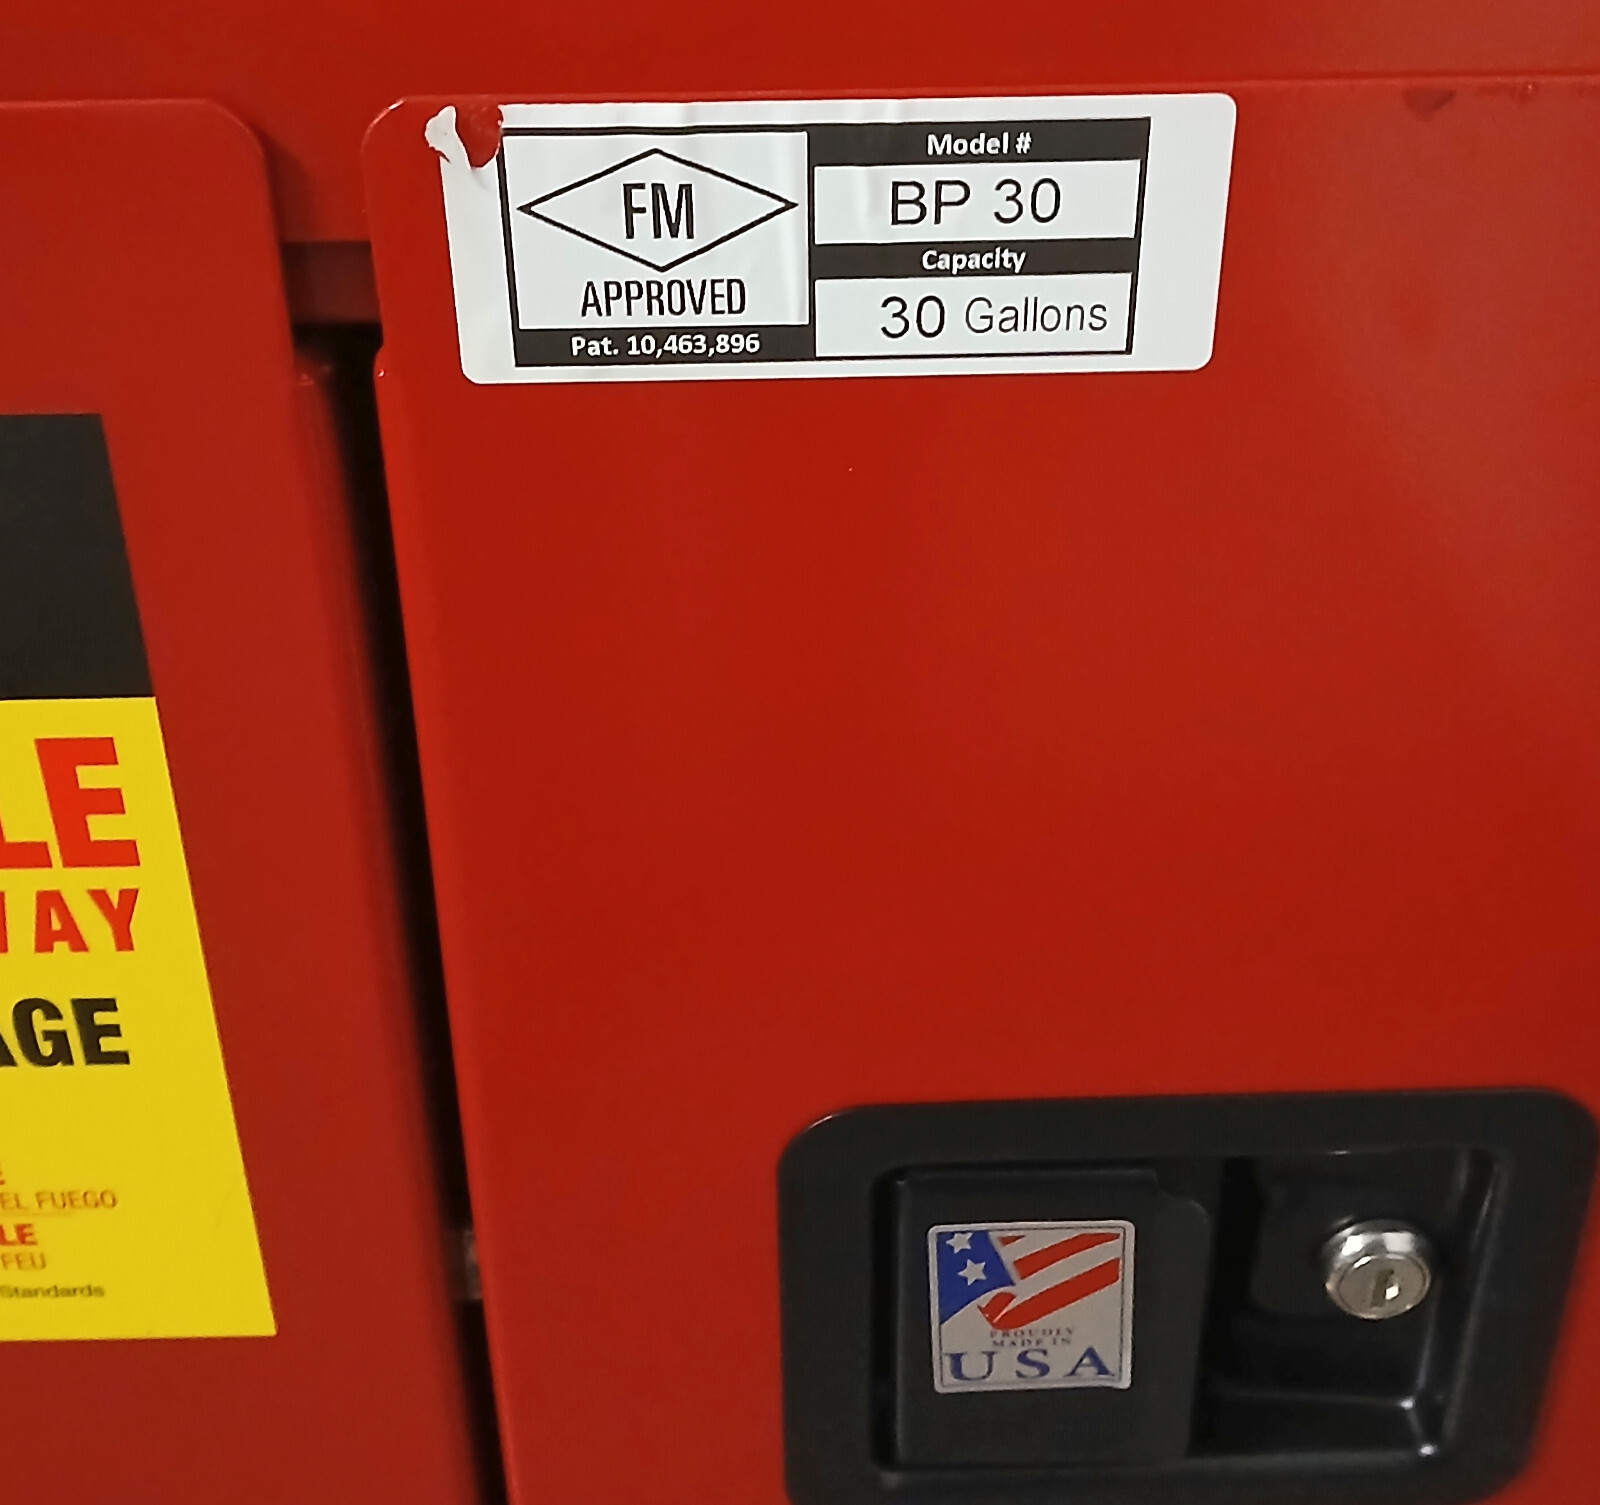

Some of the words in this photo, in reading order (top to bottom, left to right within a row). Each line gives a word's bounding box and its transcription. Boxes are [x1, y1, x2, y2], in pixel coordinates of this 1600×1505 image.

[928, 131, 1009, 157] Model
[1013, 130, 1033, 155] #
[622, 181, 697, 241] FM
[889, 180, 972, 227] BP
[992, 178, 1062, 225] 30
[922, 247, 1027, 275] Capacity
[580, 278, 747, 319] APPROVED
[879, 295, 946, 340] 30
[964, 294, 1109, 335] Gallons
[570, 334, 618, 357] Pat.
[625, 332, 761, 358] 10,463,896
[0, 888, 140, 953] AY
[35, 1189, 119, 1209] FUEGO
[0, 1284, 106, 1299] Standards
[990, 1326, 1076, 1339] PROUDLY
[992, 1337, 1045, 1348] MADE
[1052, 1336, 1073, 1347] IN
[944, 1345, 1116, 1382] USA
